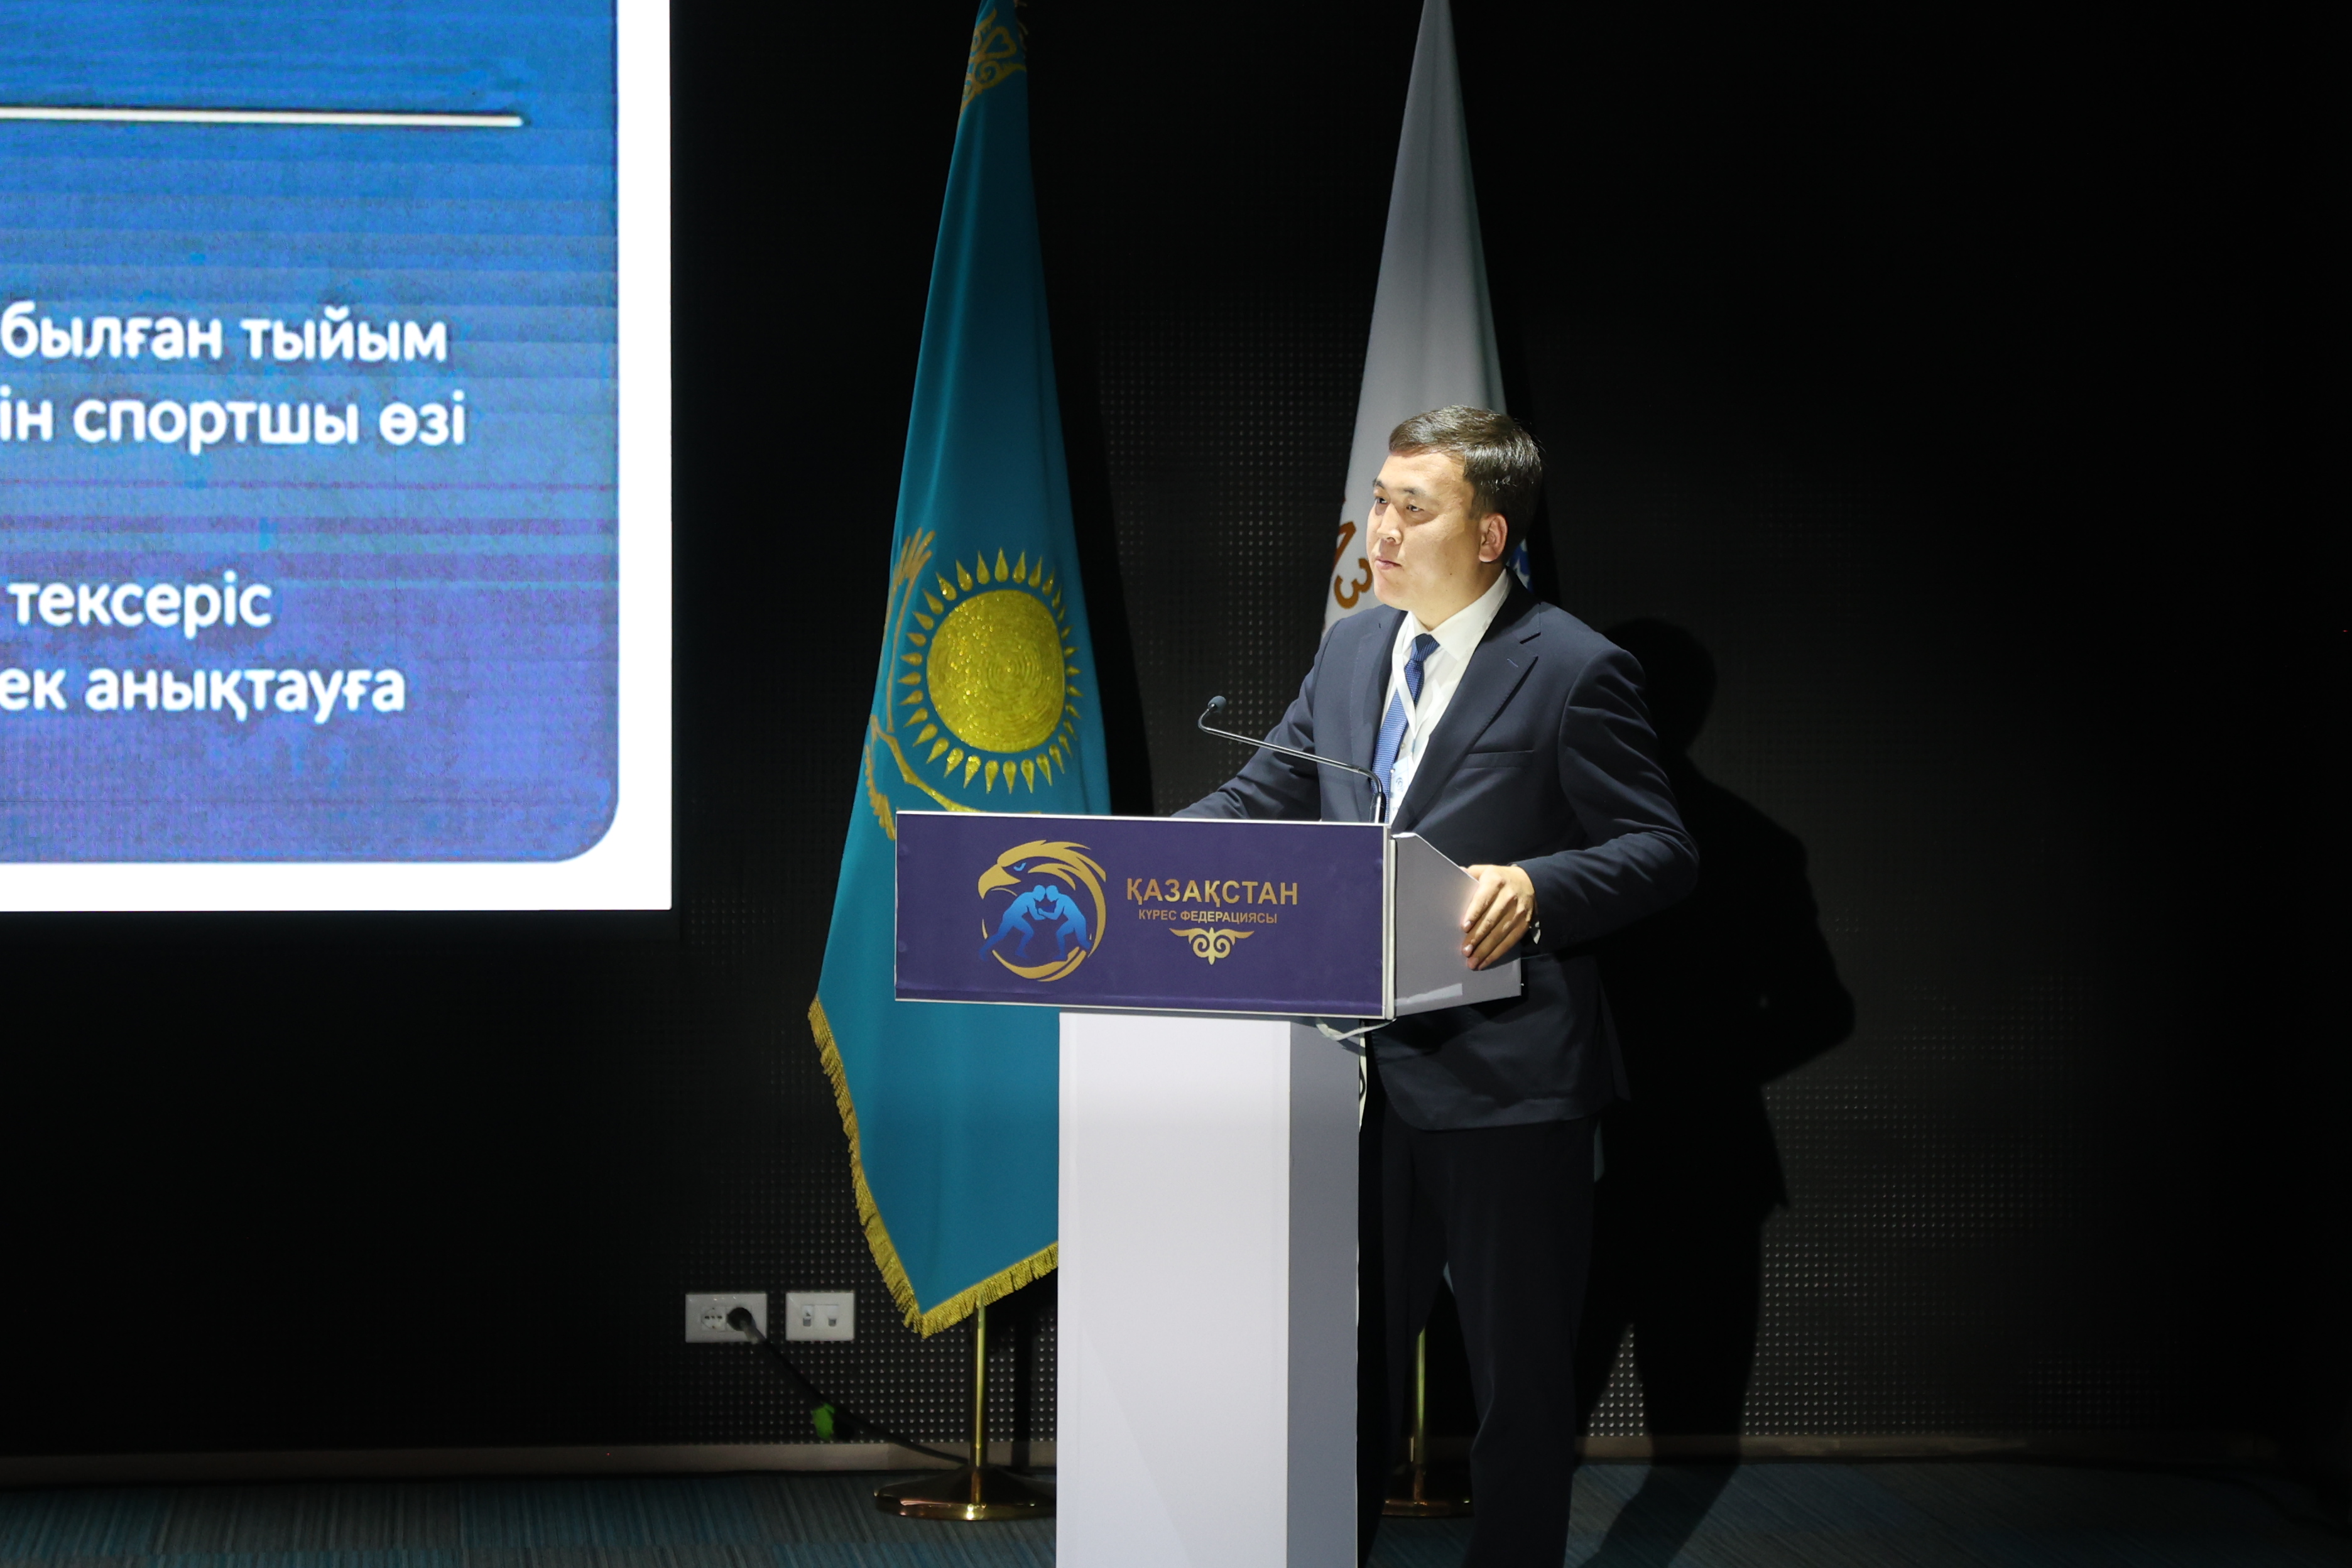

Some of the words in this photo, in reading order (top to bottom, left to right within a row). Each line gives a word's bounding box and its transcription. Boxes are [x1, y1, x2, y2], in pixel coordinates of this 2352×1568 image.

[1, 302, 222, 359] былған
[241, 306, 447, 361] тыйым
[74, 400, 358, 455] спортшы
[379, 390, 465, 445] өзі
[8, 571, 271, 638] тексеріс
[0, 668, 67, 710] ек
[85, 668, 405, 724] анықтауға
[1127, 878, 1298, 907] ҚАЗАҚСТАН
[1138, 910, 1177, 920] КҮРЕС
[1180, 911, 1278, 924] ФЕДЕРАЦИЯСЫ
